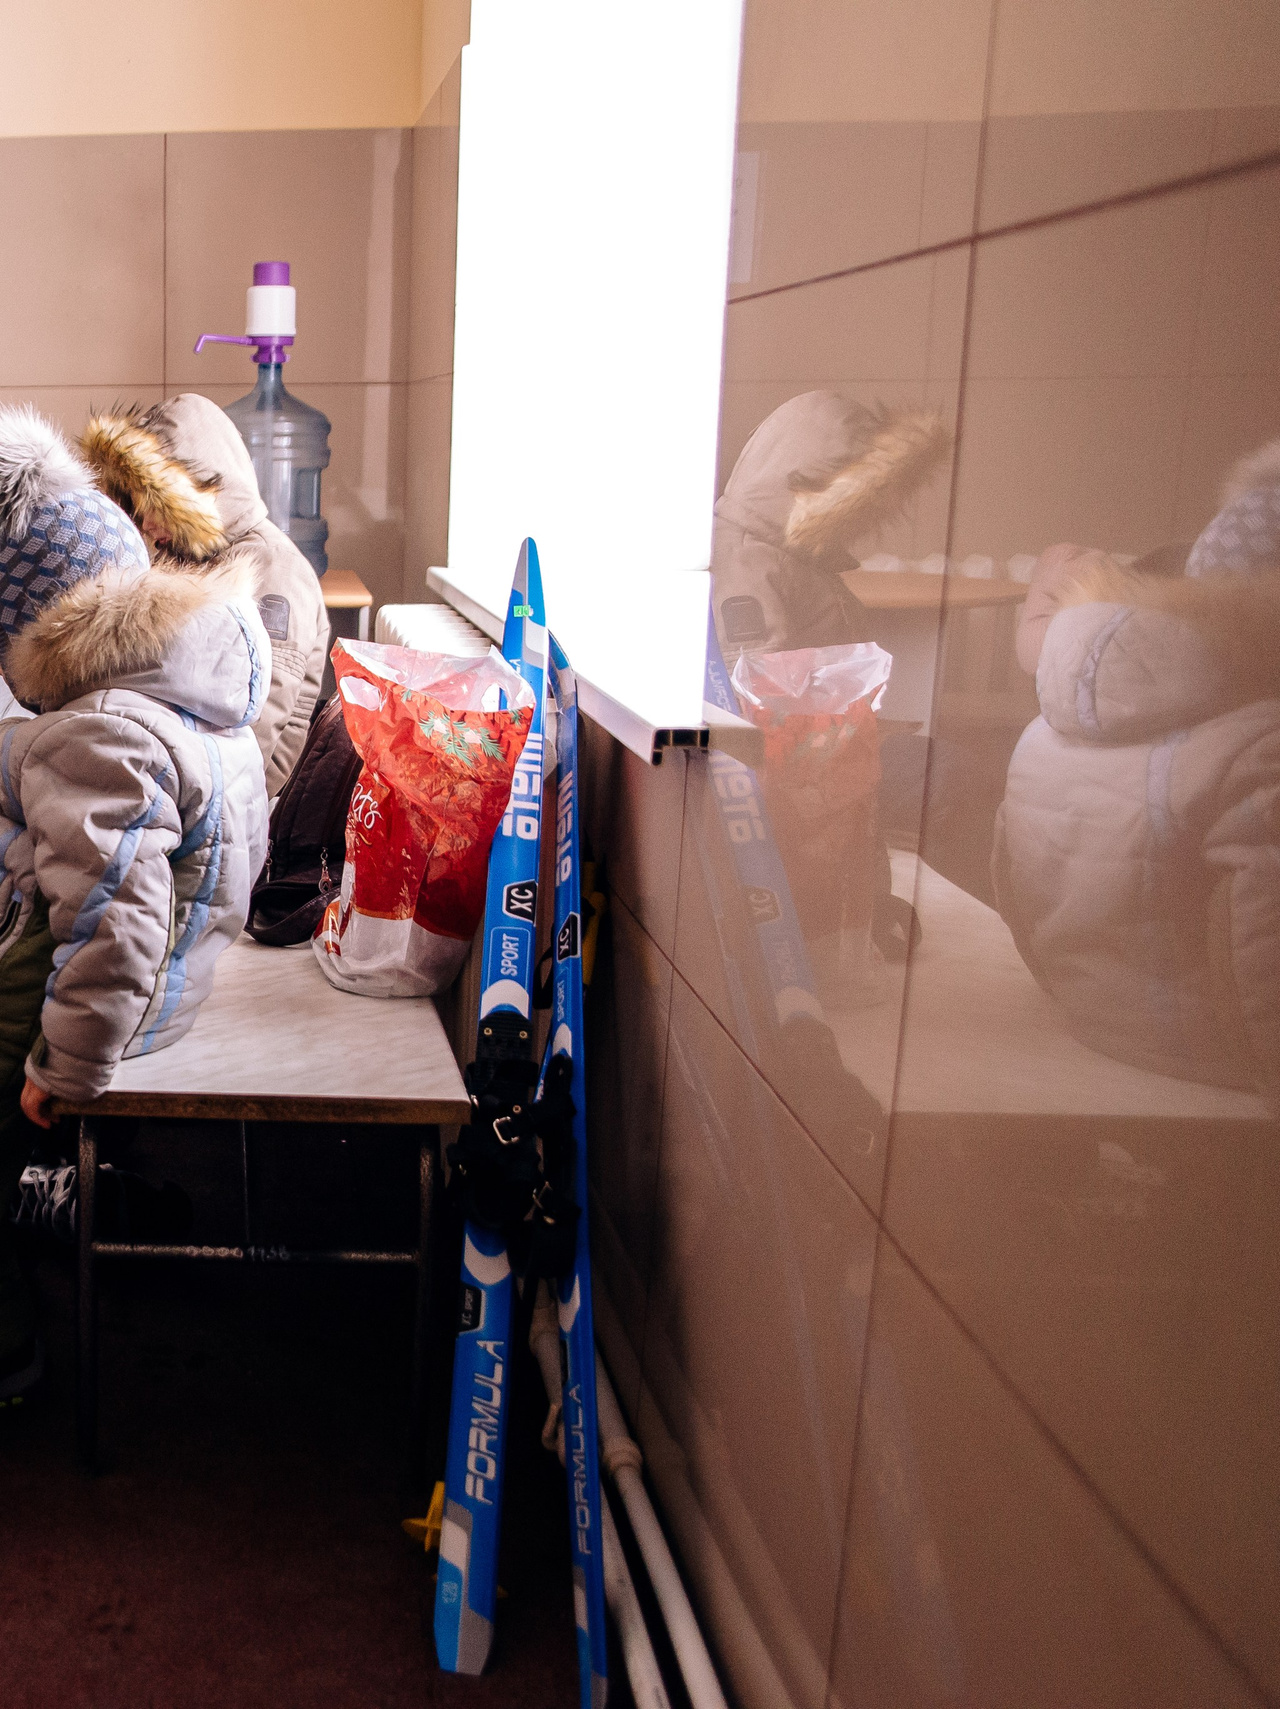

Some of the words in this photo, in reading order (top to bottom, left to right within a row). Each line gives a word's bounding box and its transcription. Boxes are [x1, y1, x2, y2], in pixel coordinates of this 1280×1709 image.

[509, 887, 534, 912] XC
[500, 933, 520, 977] SPORT
[559, 928, 570, 954] XC
[464, 1340, 505, 1505] FORMULA
[569, 1383, 591, 1554] FORMULA
